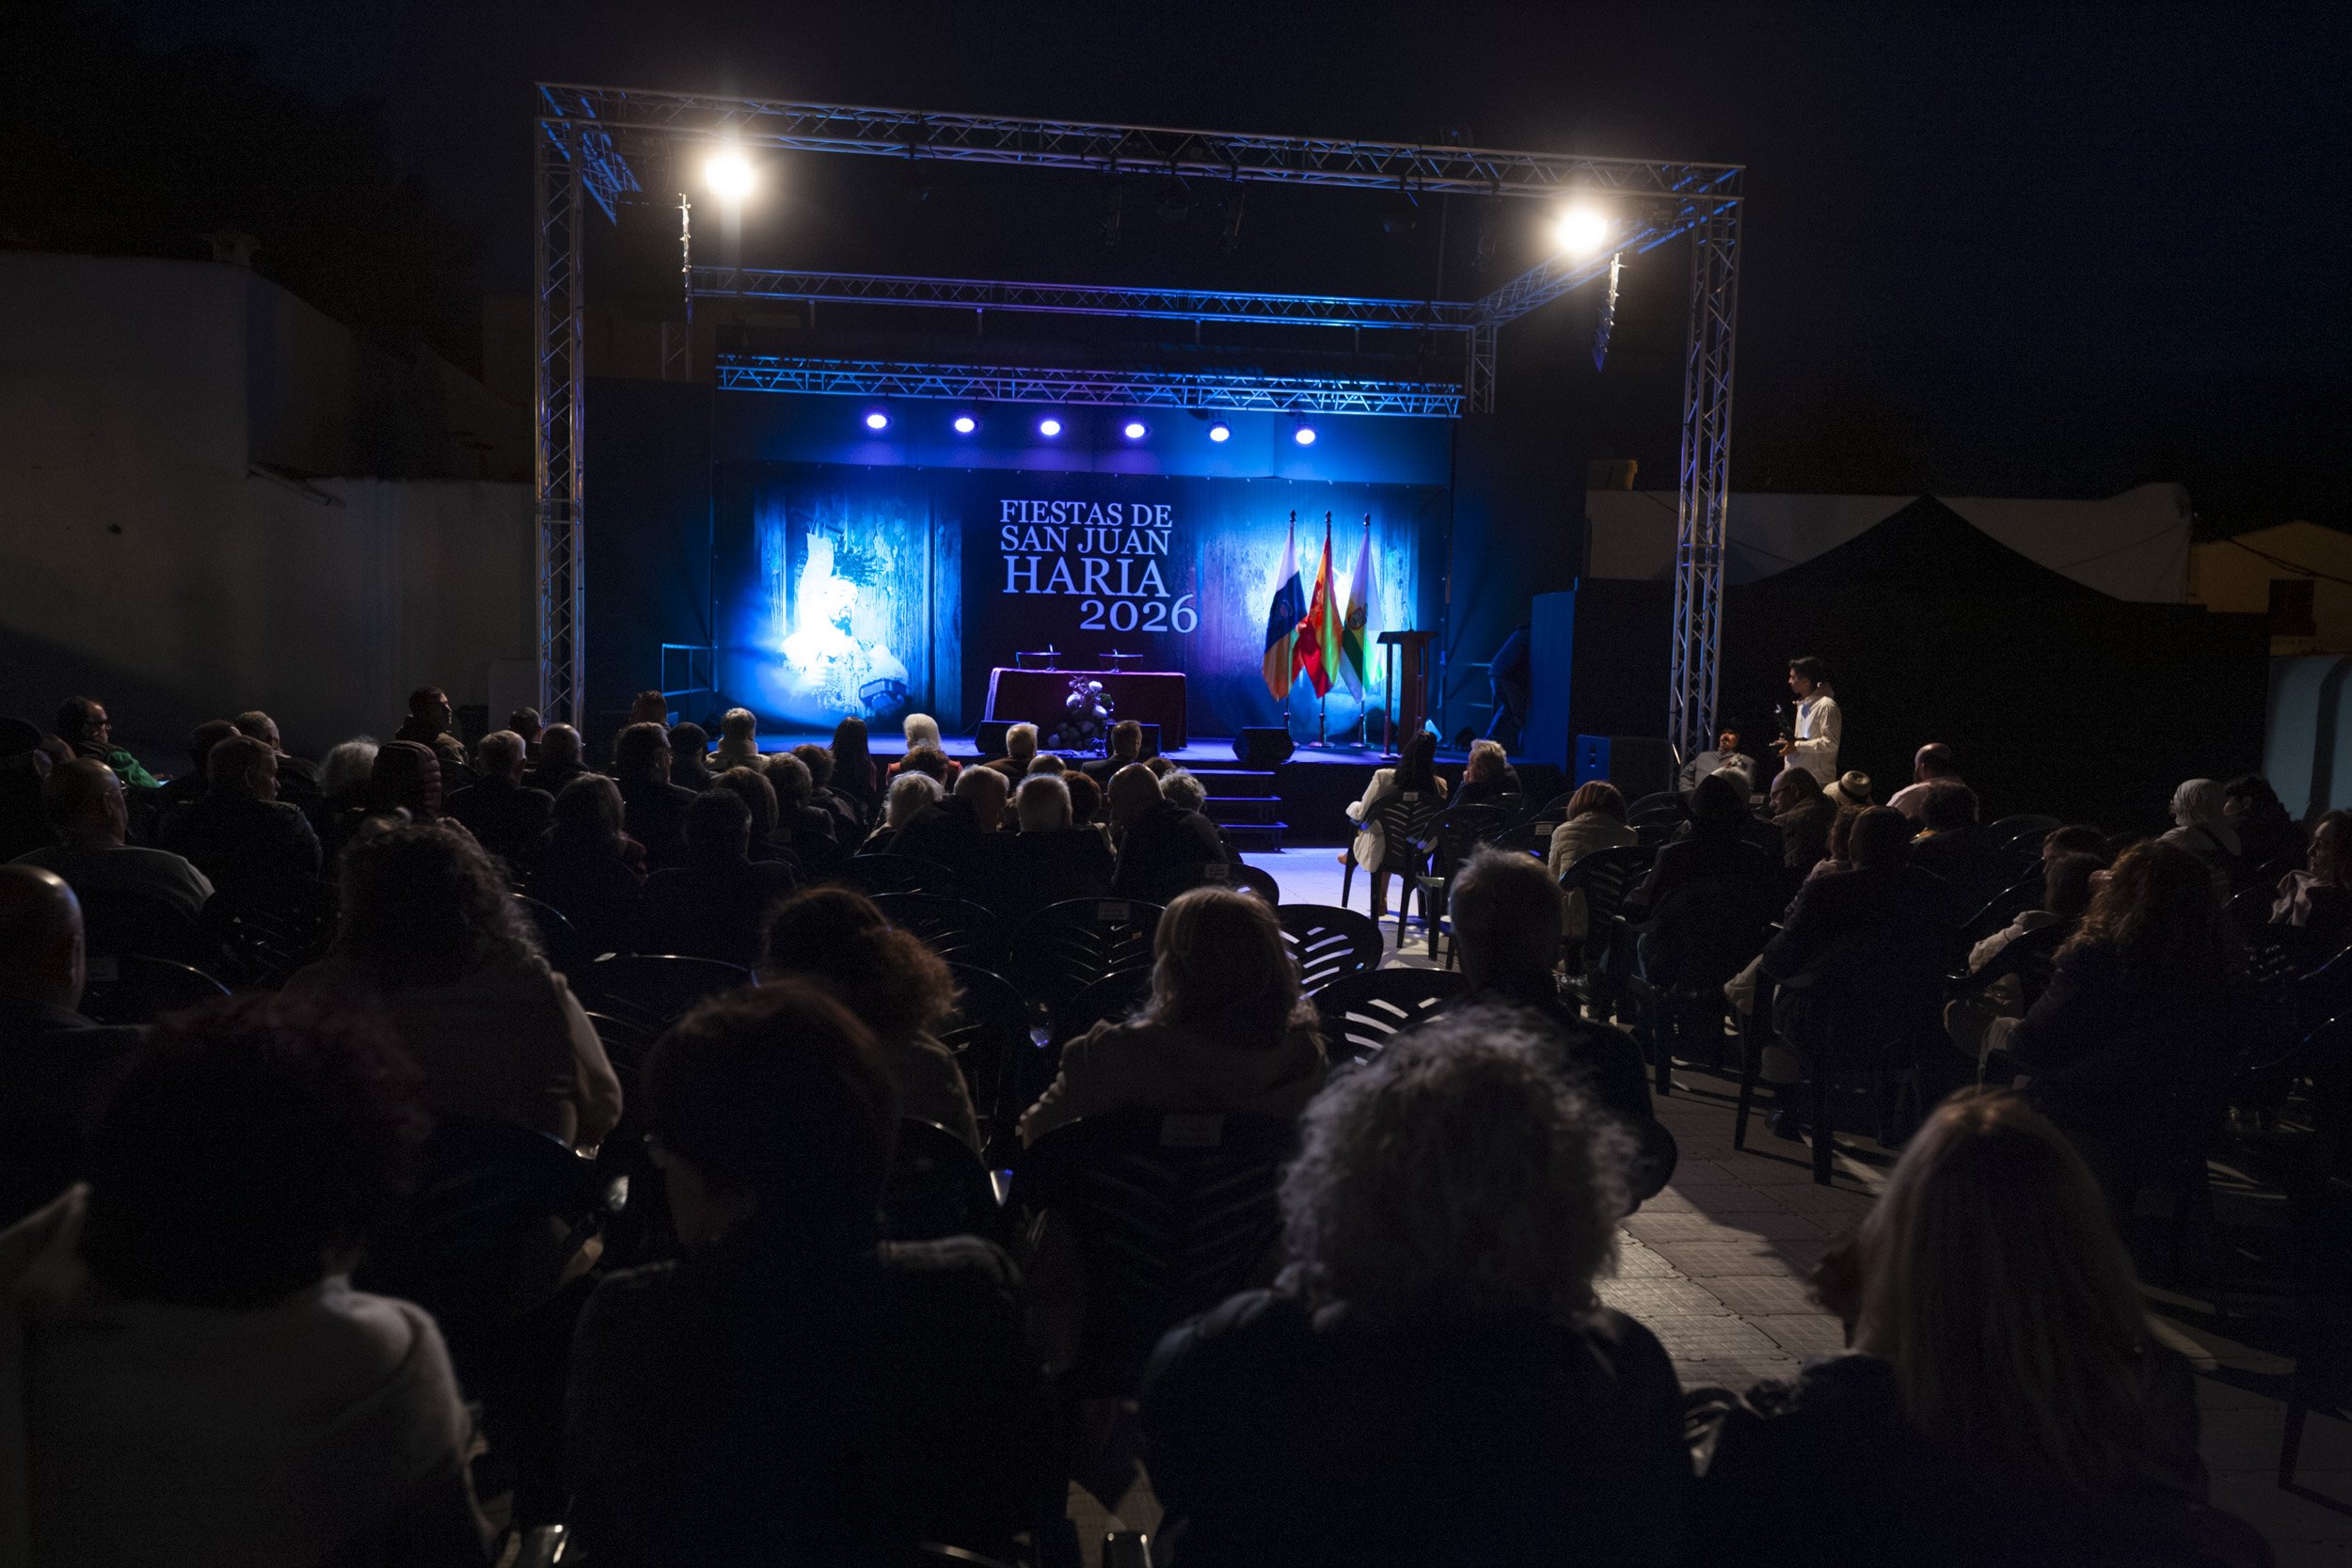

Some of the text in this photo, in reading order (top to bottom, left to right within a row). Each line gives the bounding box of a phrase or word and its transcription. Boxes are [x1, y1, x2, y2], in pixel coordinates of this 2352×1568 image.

[1000, 499, 1173, 528] FIESTAS DE
[1000, 525, 1172, 555] SAN JUAN
[1003, 555, 1170, 597] HARIA
[1080, 594, 1198, 633] 2026
